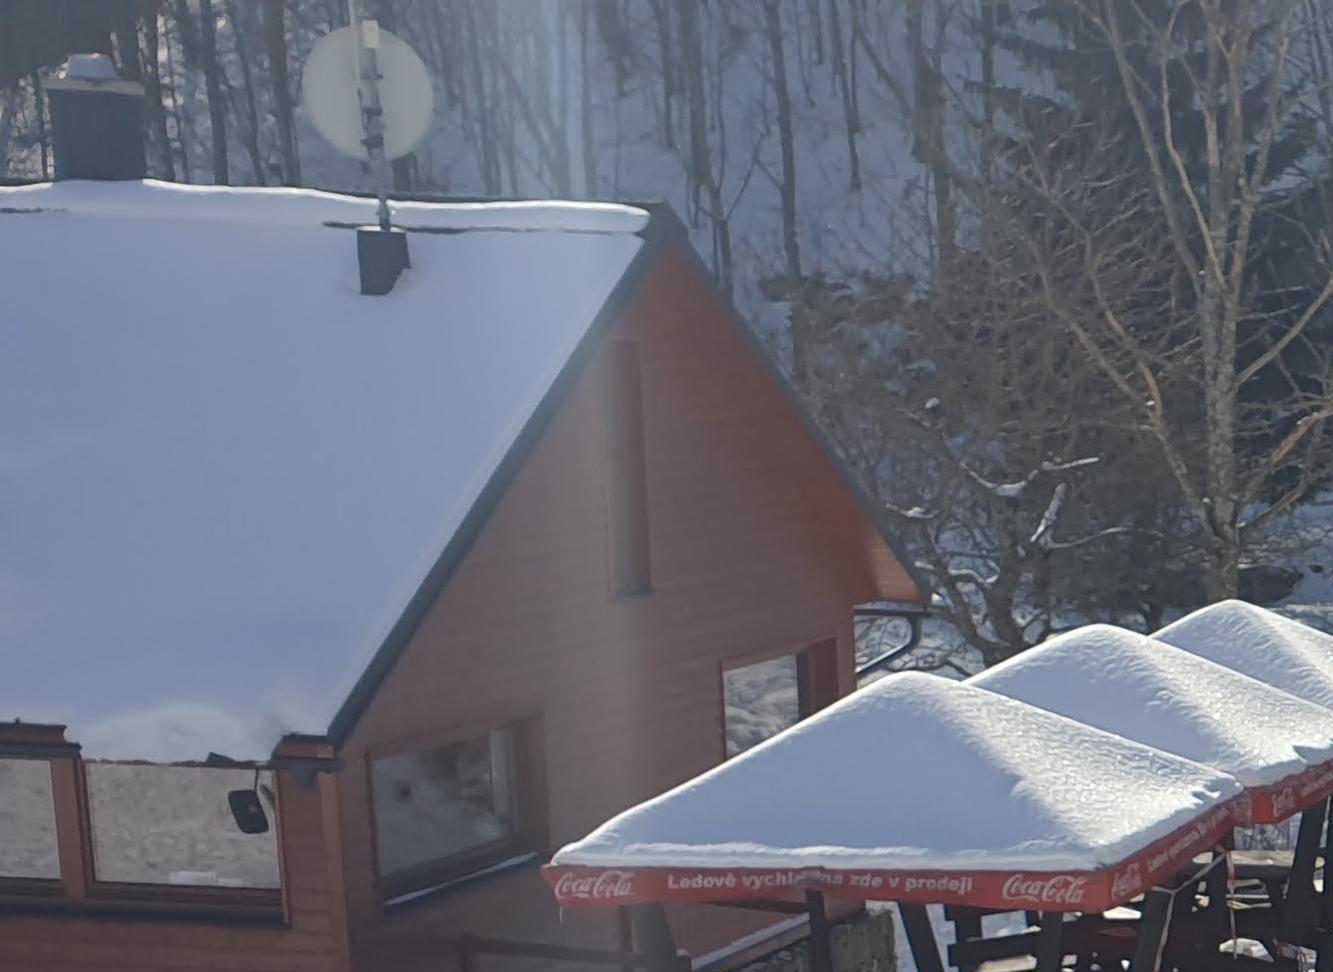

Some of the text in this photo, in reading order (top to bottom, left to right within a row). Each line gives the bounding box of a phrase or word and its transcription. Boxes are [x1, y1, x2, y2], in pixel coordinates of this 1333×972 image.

[555, 871, 635, 898] Coca-Cola
[850, 875, 883, 888] zde
[889, 878, 900, 888] v
[905, 875, 973, 896] prodeji
[1002, 874, 1087, 904] Coca-Cola
